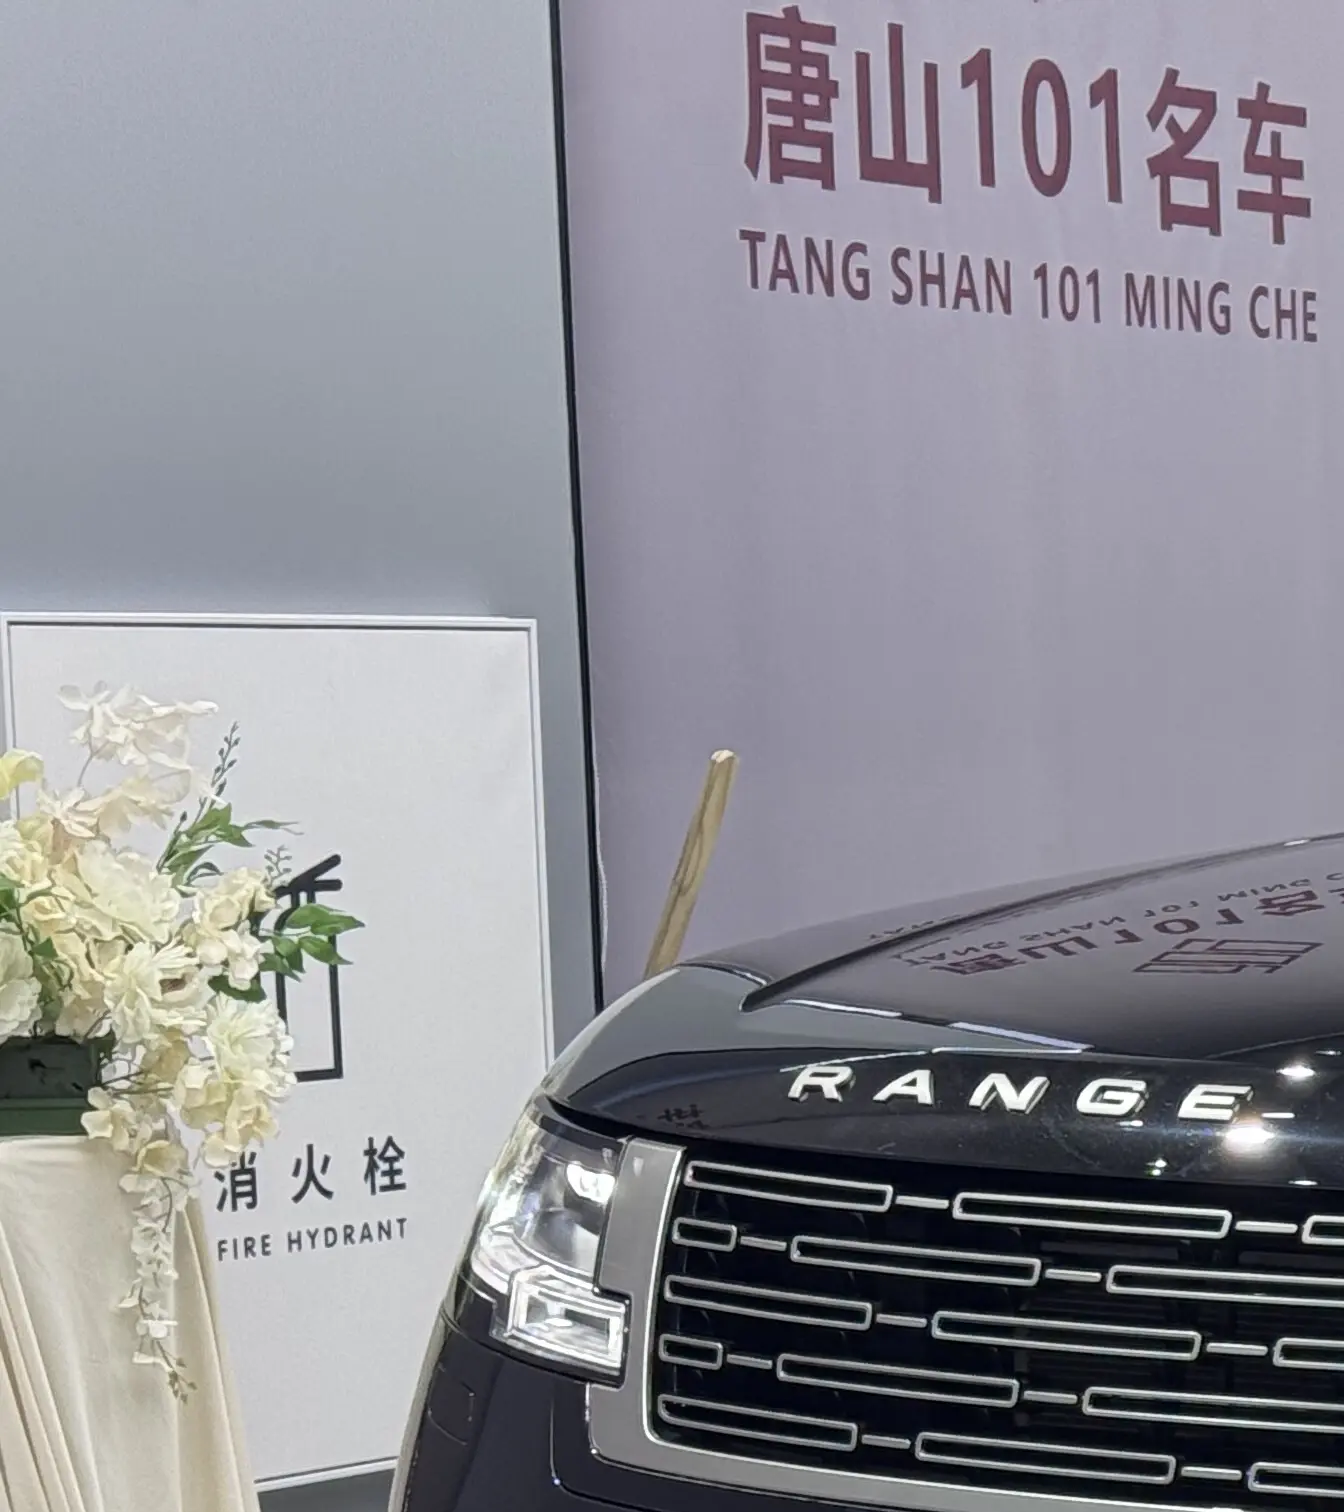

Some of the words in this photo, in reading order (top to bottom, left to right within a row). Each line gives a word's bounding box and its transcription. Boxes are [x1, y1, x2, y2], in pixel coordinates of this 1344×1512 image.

[744, 5, 1311, 245] 唐山101名车
[739, 229, 871, 301] TANG
[891, 246, 1012, 315] SHAN
[1033, 262, 1101, 323] 101
[1125, 272, 1231, 335] MING
[1248, 285, 1317, 342] CHE
[787, 1064, 1255, 1122] RANGE
[214, 1136, 406, 1212] 消火栓
[217, 1234, 271, 1261] FIRE
[287, 1218, 407, 1253] HYDRANT
